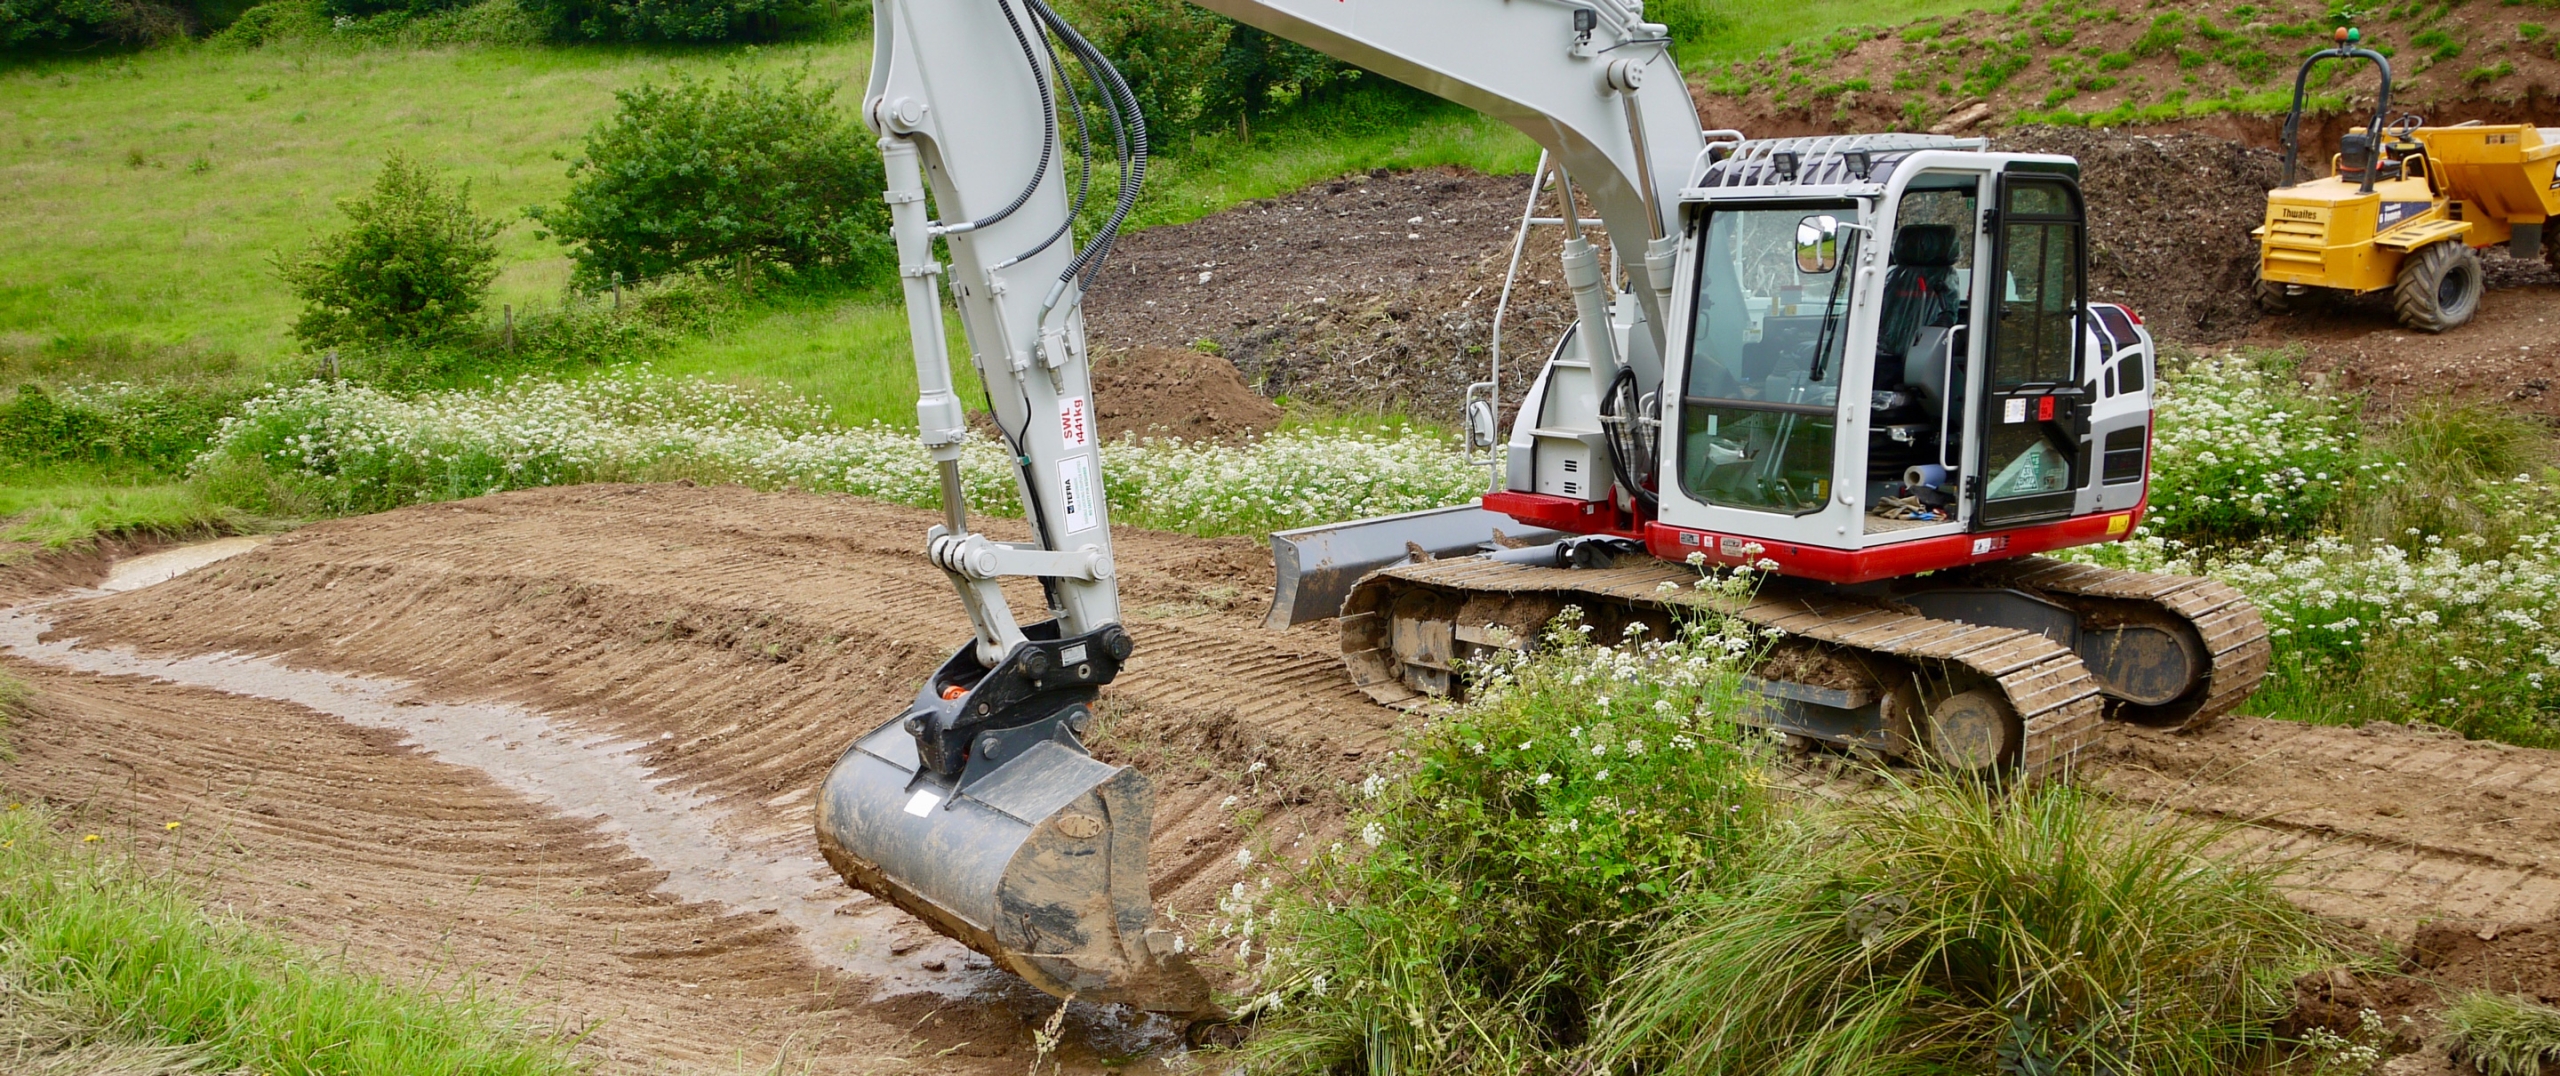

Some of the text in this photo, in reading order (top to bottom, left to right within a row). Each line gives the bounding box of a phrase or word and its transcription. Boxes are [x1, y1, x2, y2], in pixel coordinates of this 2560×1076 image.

[2283, 208, 2317, 220] Thwaites
[1061, 407, 1072, 439] SWL
[1073, 399, 1084, 445] 1441kg
[1065, 479, 1073, 505] TEFRA
